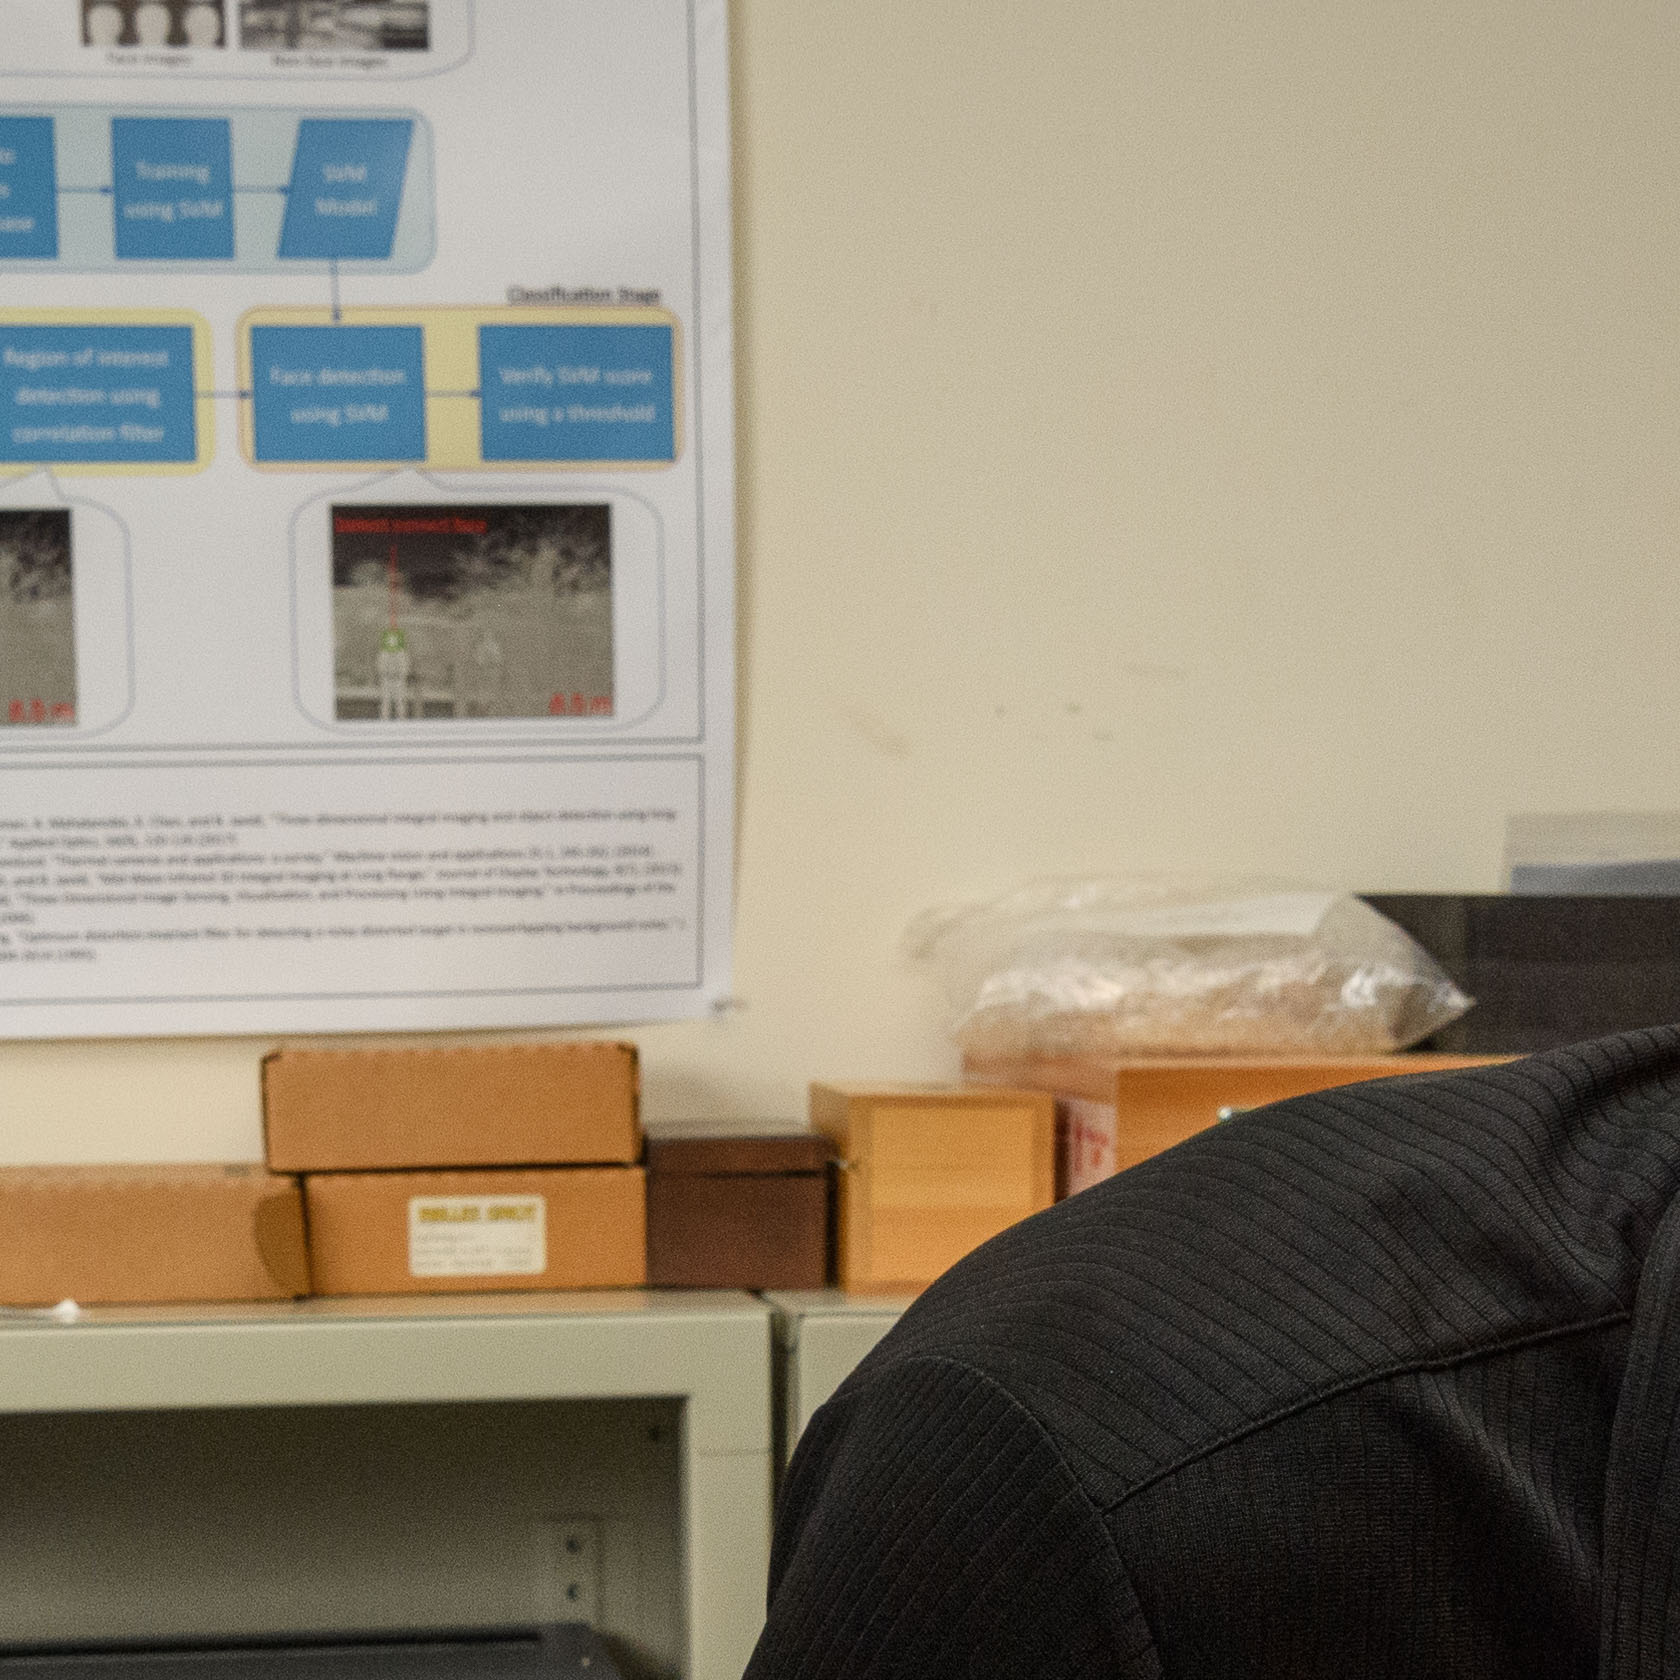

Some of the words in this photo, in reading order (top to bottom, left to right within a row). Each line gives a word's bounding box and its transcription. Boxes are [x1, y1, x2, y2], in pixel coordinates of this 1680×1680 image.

[135, 161, 211, 184] Training
[324, 164, 367, 183] SVM
[124, 201, 173, 223] using
[178, 200, 222, 218] SVM
[316, 198, 378, 217] Model
[508, 285, 611, 305] Classification
[3, 349, 67, 370] Region
[72, 348, 94, 366] of
[98, 349, 168, 367] interest
[269, 366, 312, 385] Face
[316, 366, 405, 385] detection
[499, 367, 553, 387] Verify
[557, 367, 599, 385] SVM
[604, 369, 652, 385] score
[15, 388, 105, 406] detection
[109, 390, 160, 409] using
[291, 408, 342, 427] using
[345, 405, 388, 423] SVM
[500, 407, 547, 426] using
[567, 405, 655, 423] threshold
[12, 425, 116, 443] correlation
[119, 423, 165, 442] filter
